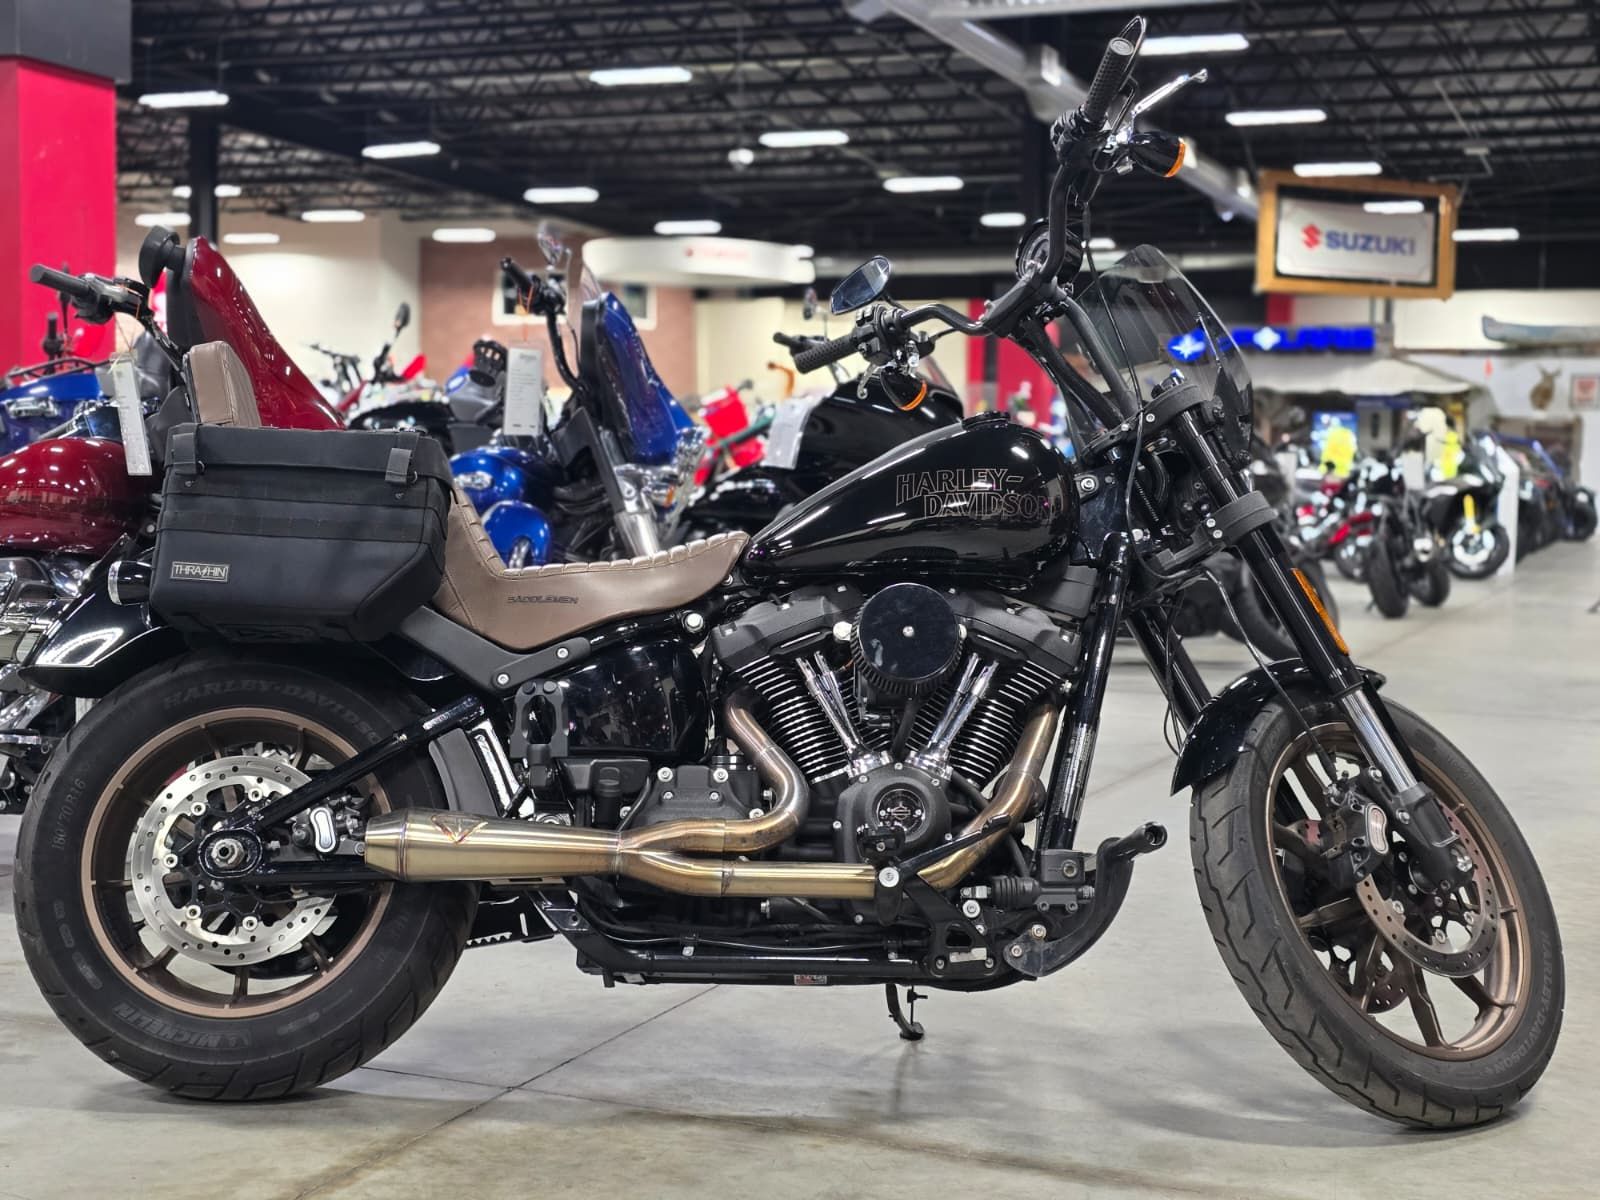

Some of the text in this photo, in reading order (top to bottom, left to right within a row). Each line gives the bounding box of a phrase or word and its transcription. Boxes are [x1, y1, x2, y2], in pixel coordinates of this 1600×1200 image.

[1325, 230, 1416, 255] SUZUKI
[896, 469, 1024, 506] HARLEY-
[924, 492, 1063, 520] DAVIDSON
[113, 1002, 220, 1048] MICHELIN
